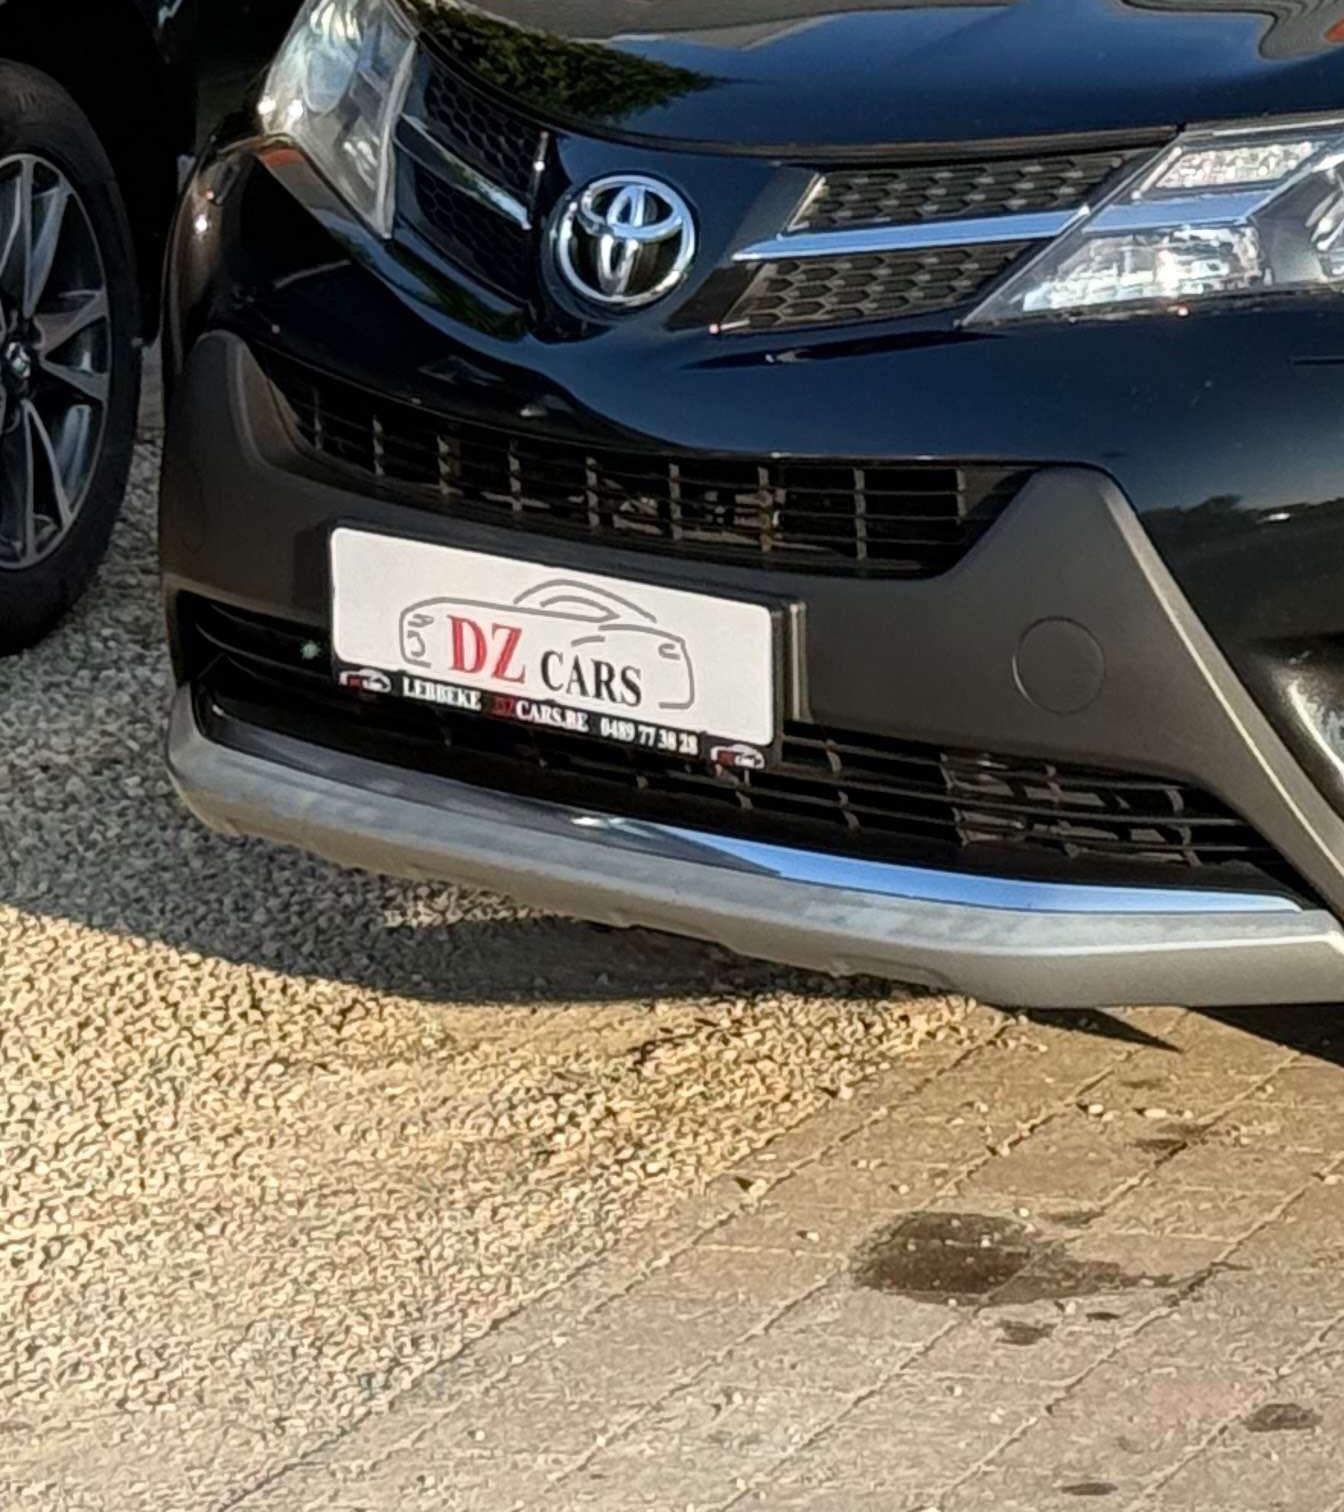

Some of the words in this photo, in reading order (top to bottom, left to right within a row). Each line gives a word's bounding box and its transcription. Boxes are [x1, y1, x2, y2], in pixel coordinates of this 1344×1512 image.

[445, 613, 527, 685] DZ
[540, 649, 642, 708] CARS
[402, 676, 482, 711] LEBBEKE
